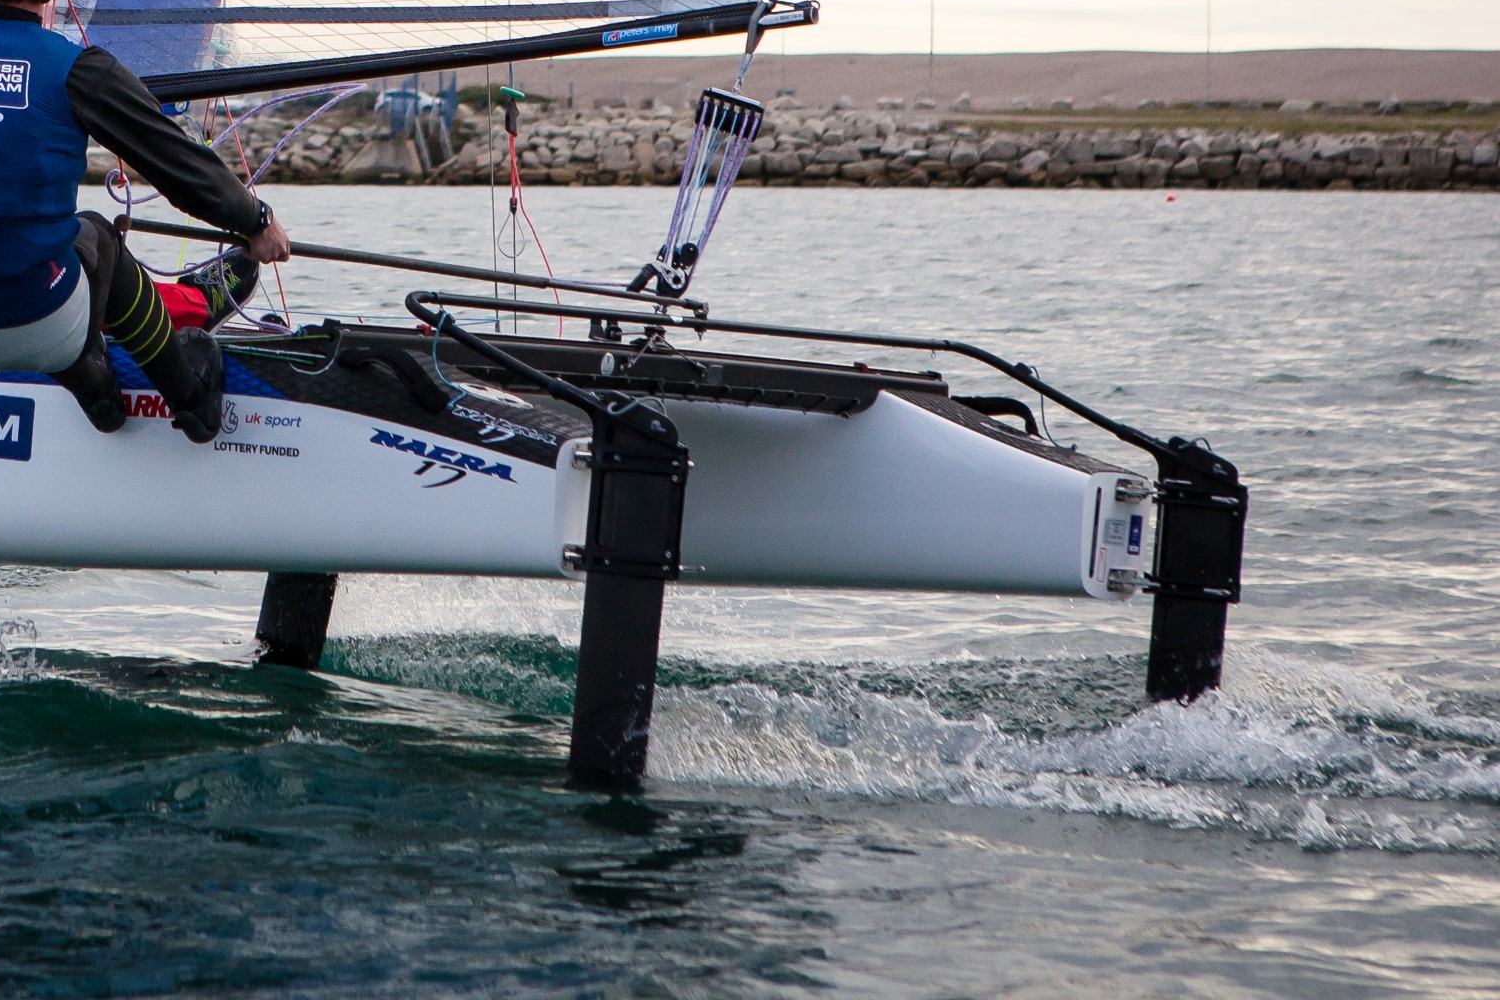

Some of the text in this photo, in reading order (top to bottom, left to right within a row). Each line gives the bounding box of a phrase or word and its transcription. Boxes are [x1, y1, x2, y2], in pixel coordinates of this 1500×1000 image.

[619, 24, 675, 40] peters may
[245, 411, 302, 430] uk sport
[214, 440, 300, 458] LOTTERY FUNDED
[413, 460, 467, 489] 17
